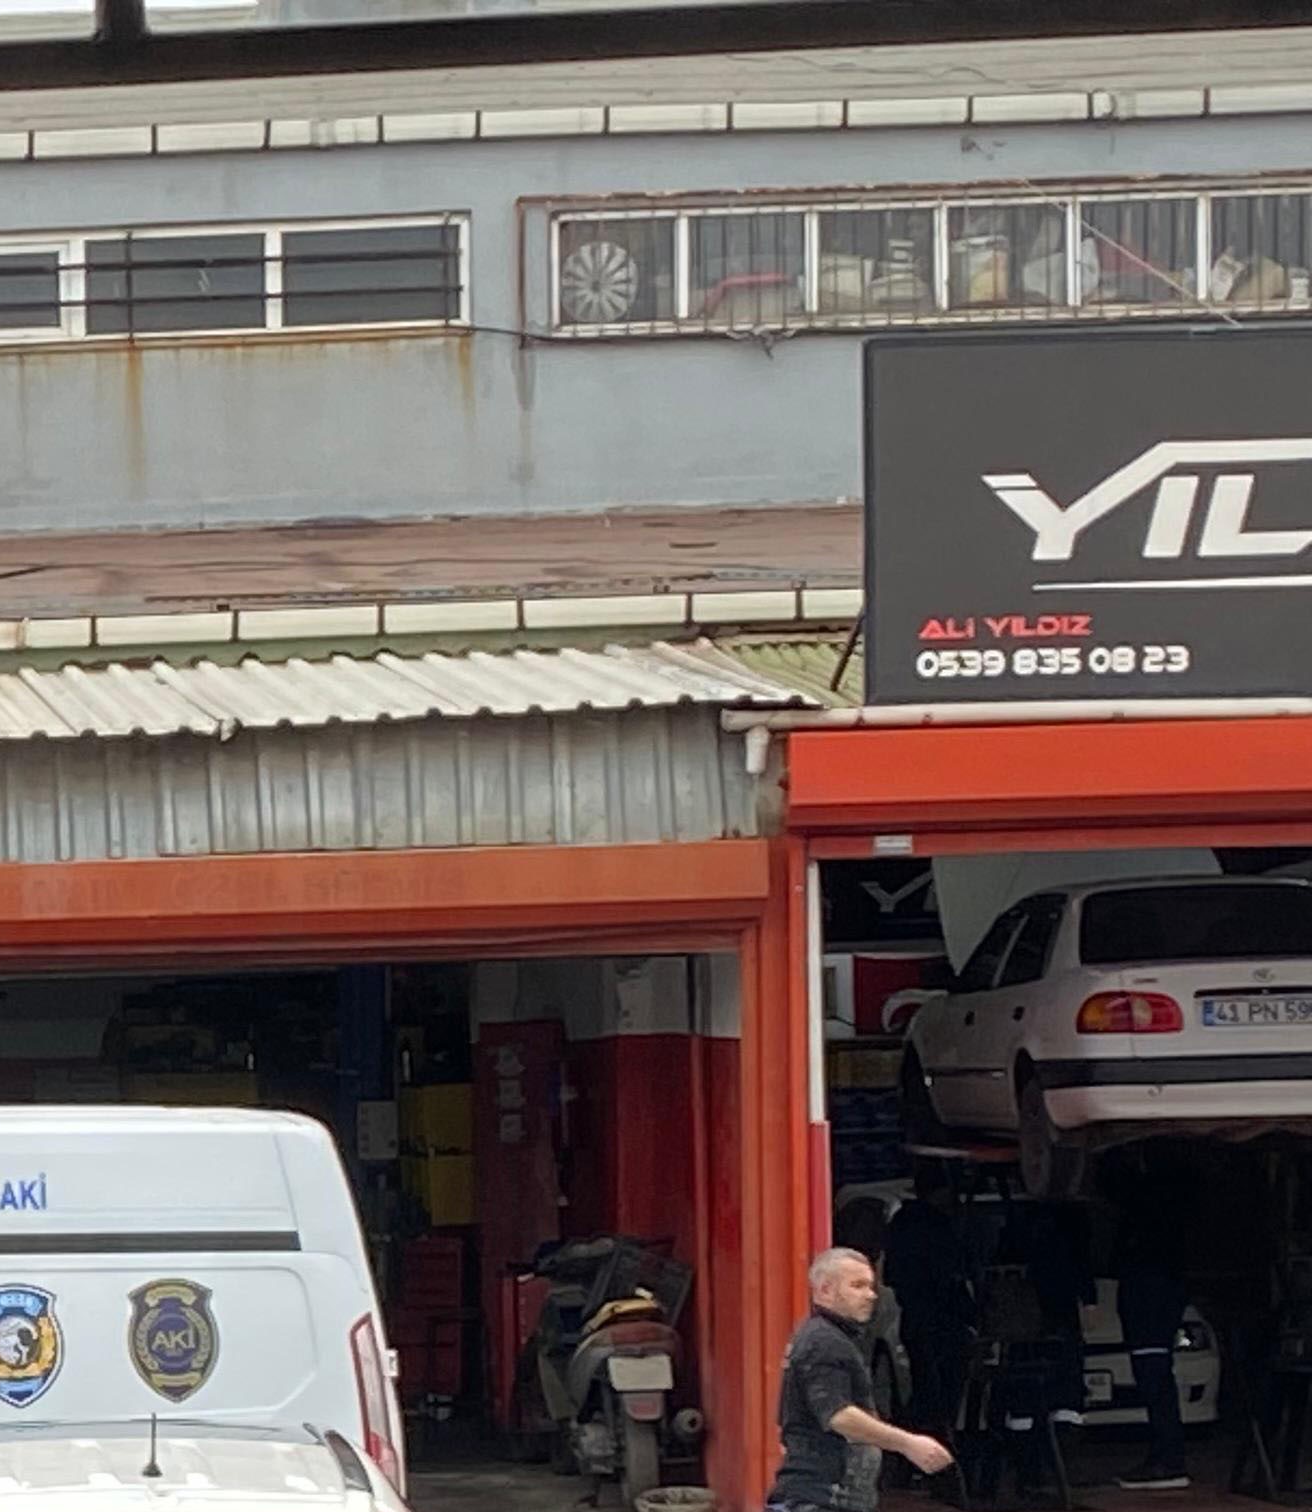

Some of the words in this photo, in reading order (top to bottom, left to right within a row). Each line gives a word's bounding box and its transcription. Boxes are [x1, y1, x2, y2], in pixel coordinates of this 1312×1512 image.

[983, 614, 1092, 638] YILDIZ
[916, 649, 1006, 678] 0539
[1012, 647, 1081, 676] 835
[1088, 646, 1136, 674] 08
[1142, 645, 1190, 673] 23
[0, 1172, 48, 1211] AKİ
